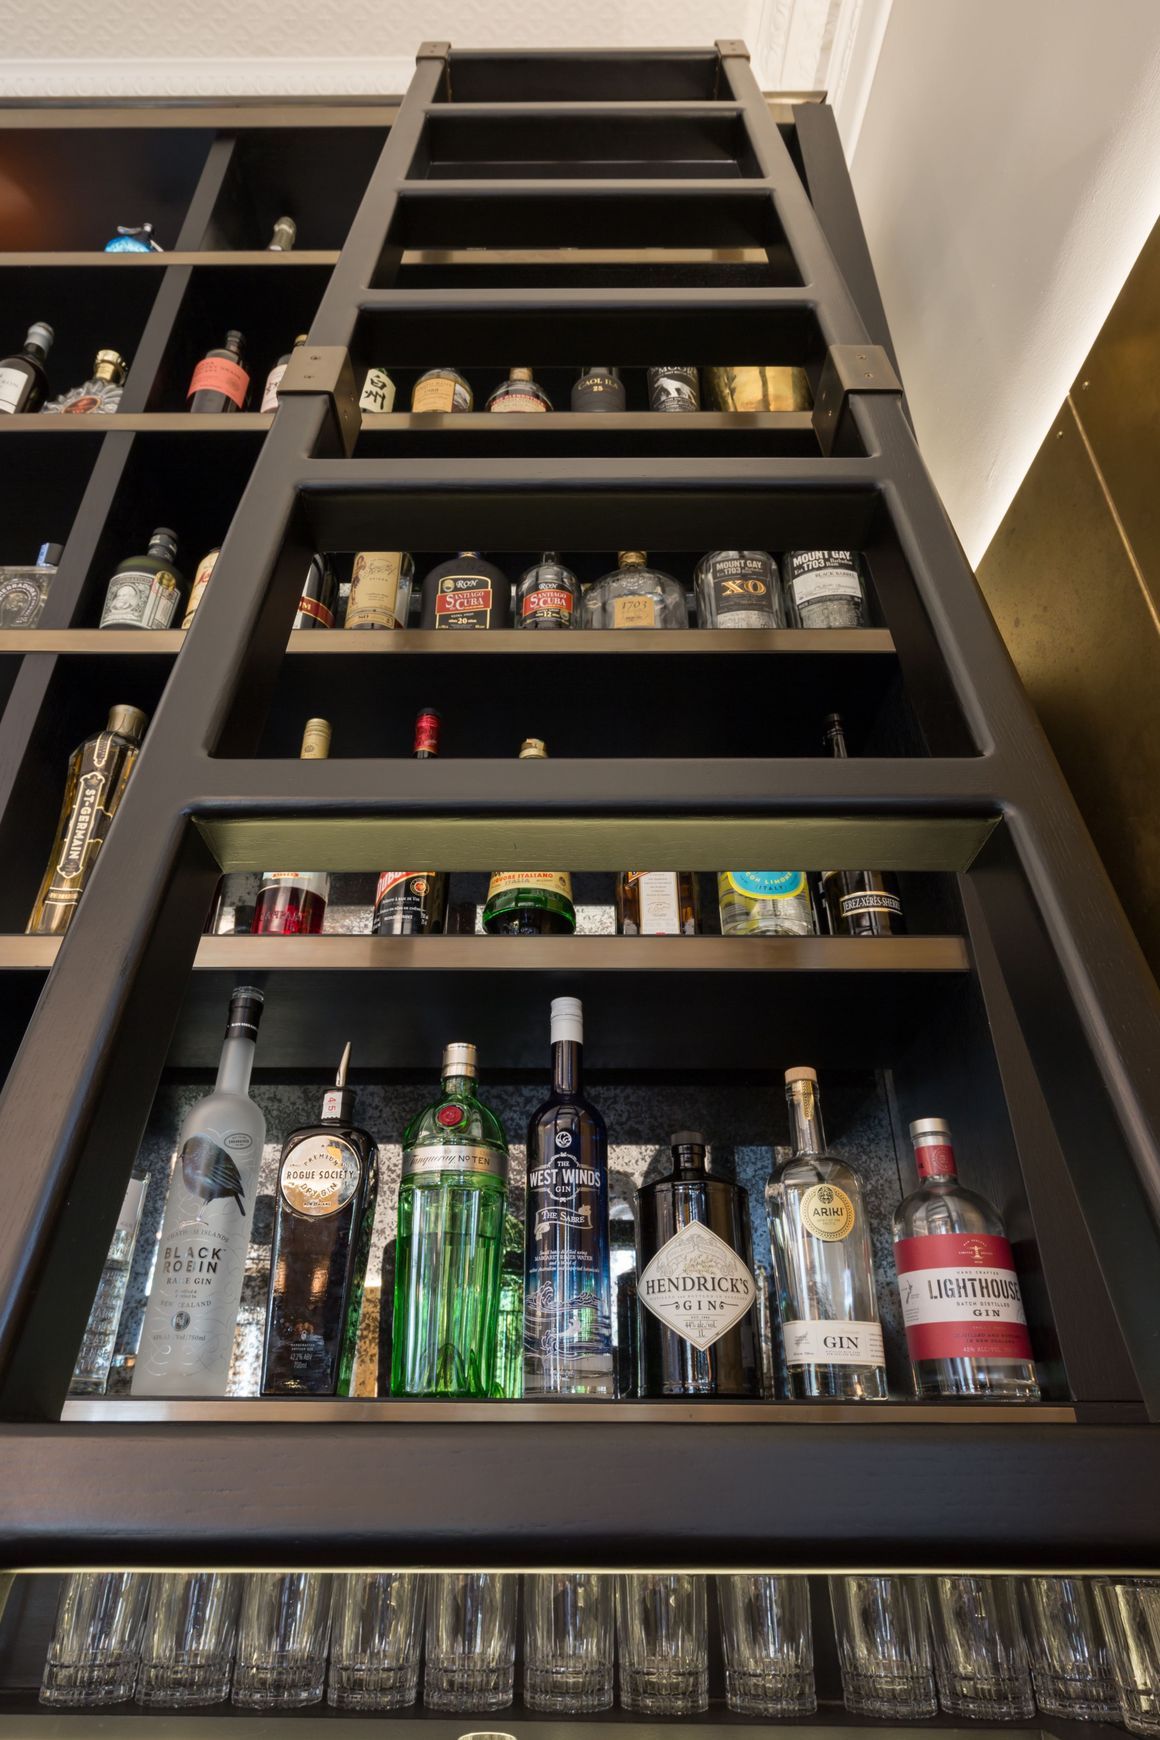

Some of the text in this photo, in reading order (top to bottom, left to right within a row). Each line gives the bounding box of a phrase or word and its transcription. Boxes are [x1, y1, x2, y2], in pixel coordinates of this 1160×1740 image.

[578, 378, 618, 390] CAOL ILA
[364, 375, 387, 410] 白州
[793, 551, 850, 567] MOUNT GAY
[803, 559, 825, 571] 1703
[716, 560, 762, 571] MOUNT GAY
[724, 567, 741, 575] 1703
[456, 580, 478, 589] RON
[721, 580, 767, 596] XO
[446, 592, 484, 608] SANTIAGO
[456, 598, 483, 610] CUBA
[530, 592, 567, 608] SANTIAGO
[540, 597, 566, 607] CUBA
[69, 788, 96, 859] ST-GERMAIN
[304, 1154, 339, 1167] PREMIUM
[472, 1156, 490, 1165] TEN
[287, 1171, 354, 1180] ROGUE SOCIETY
[529, 1169, 600, 1187] WEST WINDS
[301, 1183, 337, 1196] DRY GIN
[813, 1207, 844, 1217] ARIKI
[164, 1247, 221, 1260] BLACK
[163, 1261, 218, 1273] ROBIN
[193, 1277, 213, 1285] GIN
[646, 1276, 749, 1295] HENDRICK'S
[928, 1278, 1021, 1301] LIGHTHOUSE
[683, 1300, 718, 1311] GIN
[973, 1309, 1001, 1317] GIN
[823, 1336, 858, 1349] GIN
